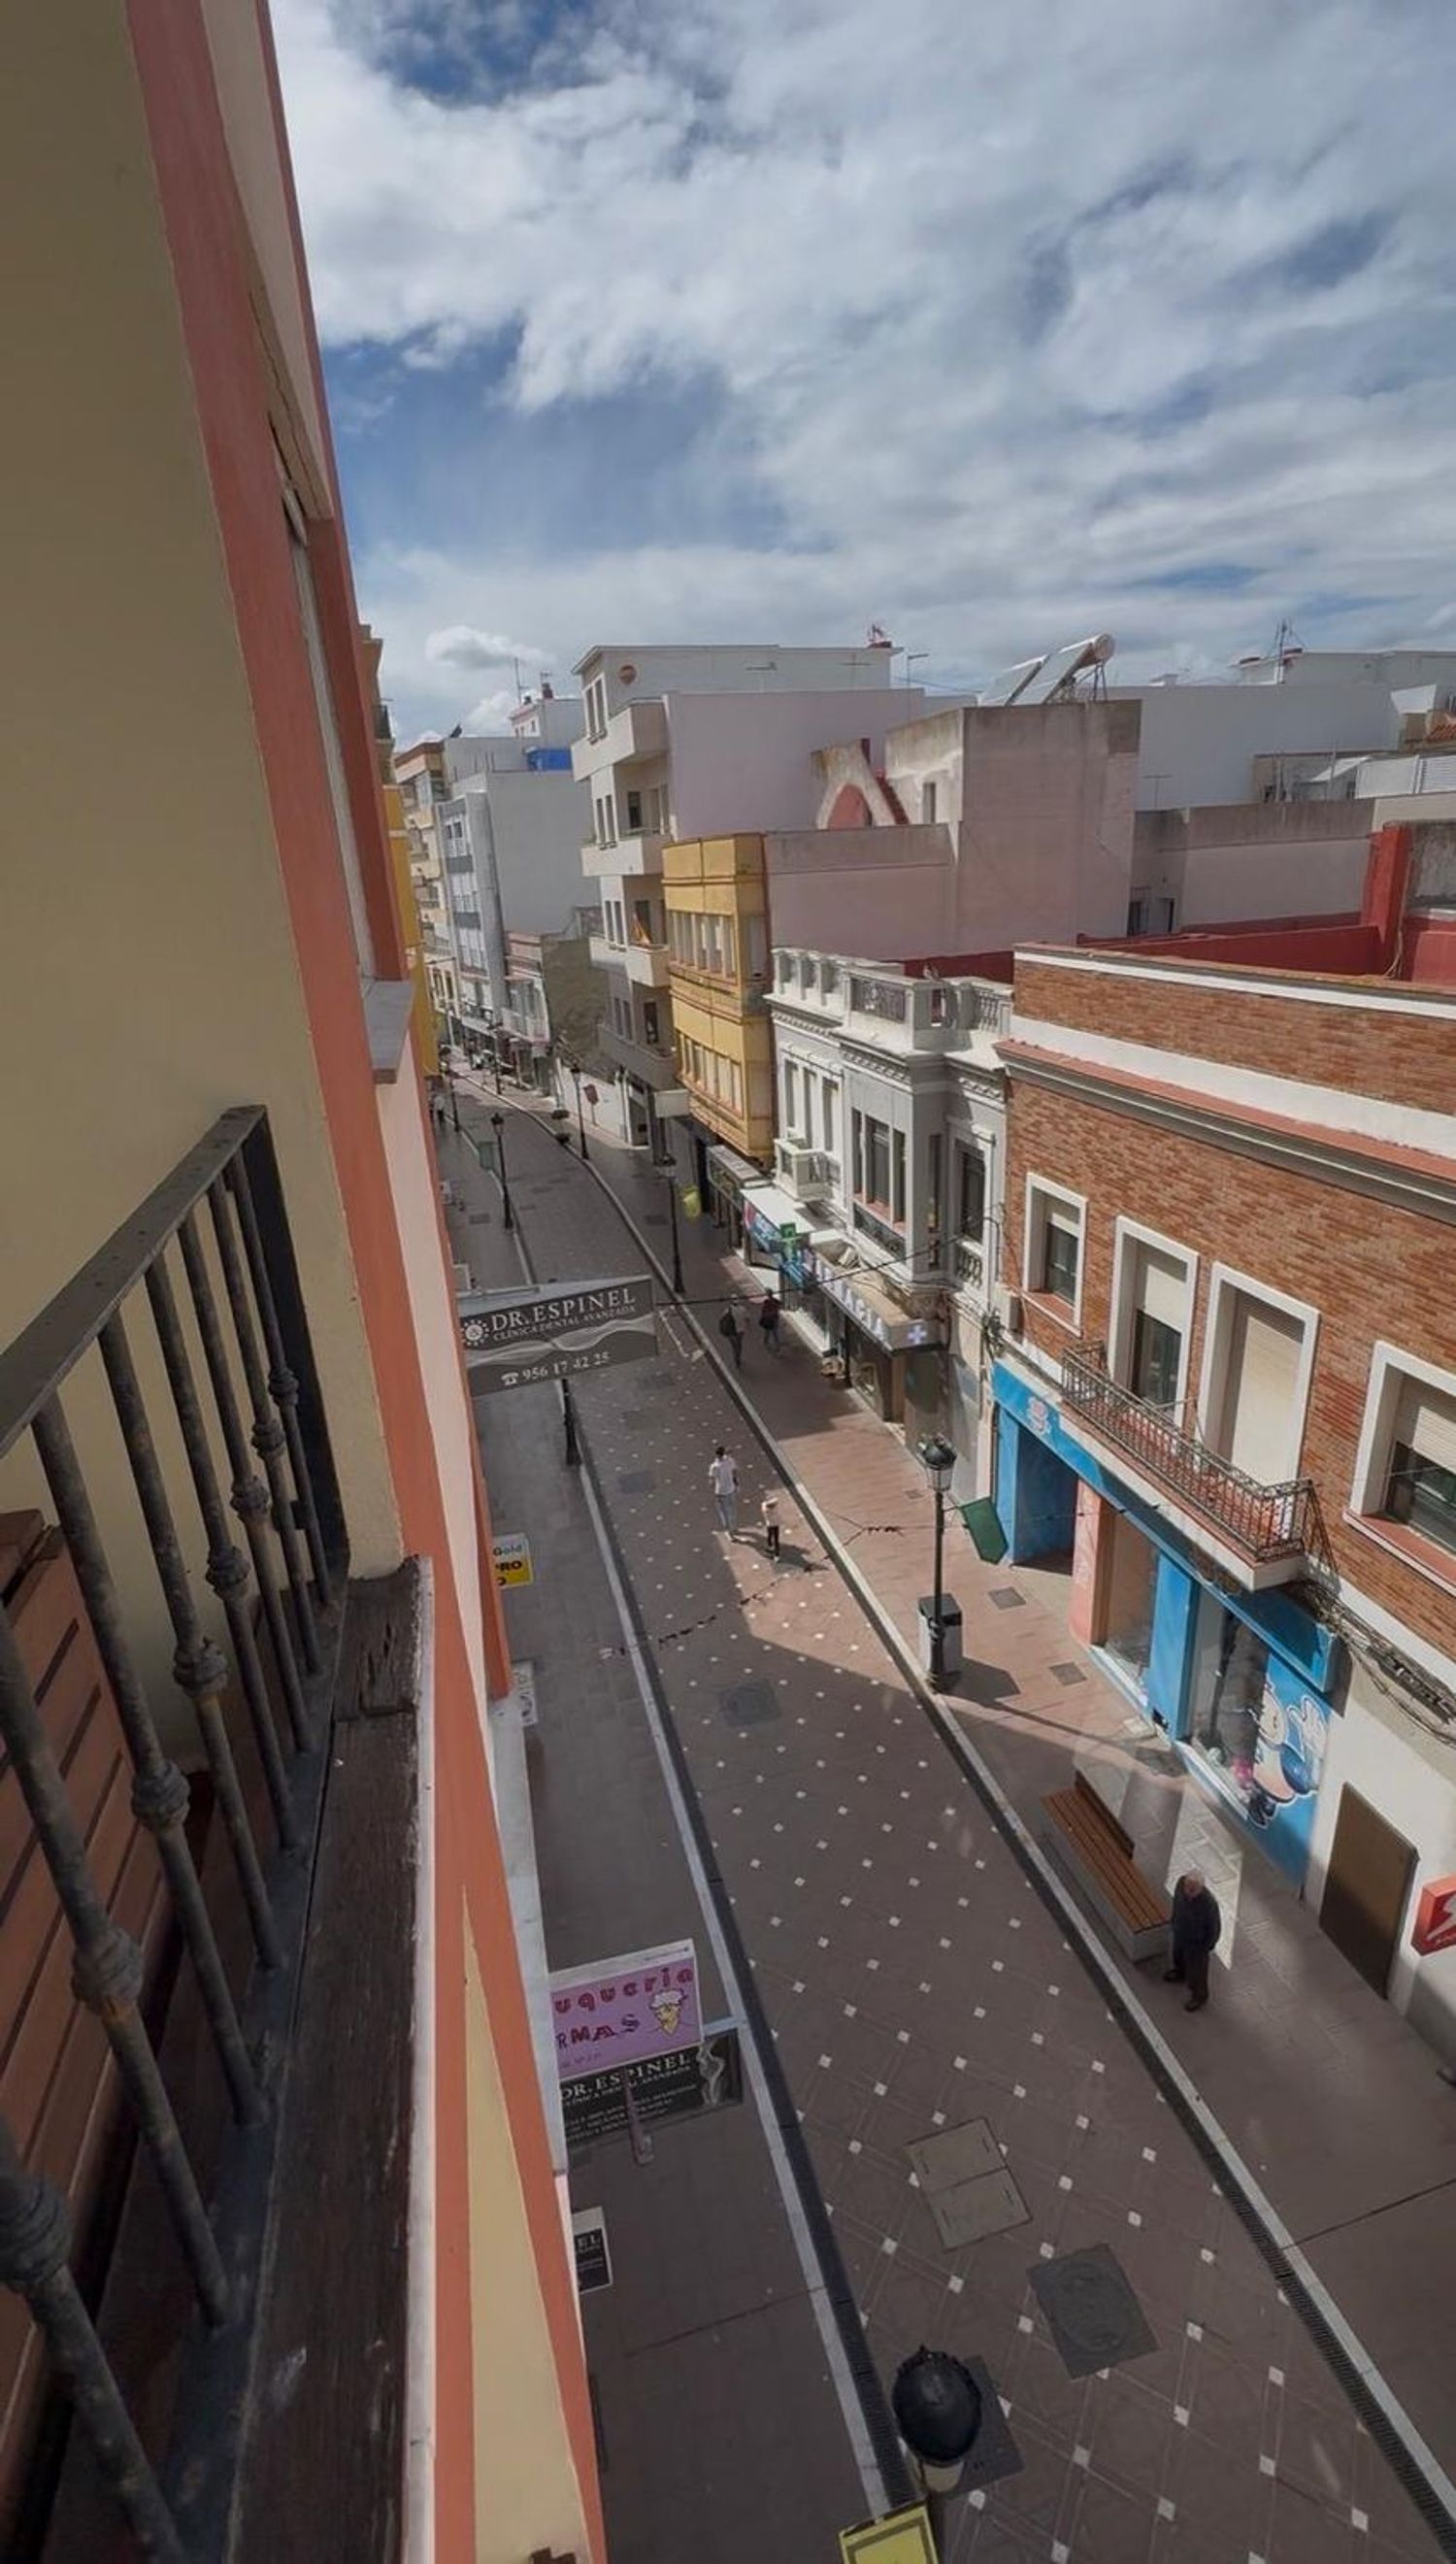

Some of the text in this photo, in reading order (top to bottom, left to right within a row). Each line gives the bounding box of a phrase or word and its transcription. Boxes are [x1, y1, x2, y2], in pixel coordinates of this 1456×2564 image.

[491, 1288, 636, 1331] DR. ESPINEL
[541, 1317, 580, 1331] DENTAL
[583, 1306, 636, 1321] AVANZADA
[522, 1351, 611, 1381] 956 17 42 25
